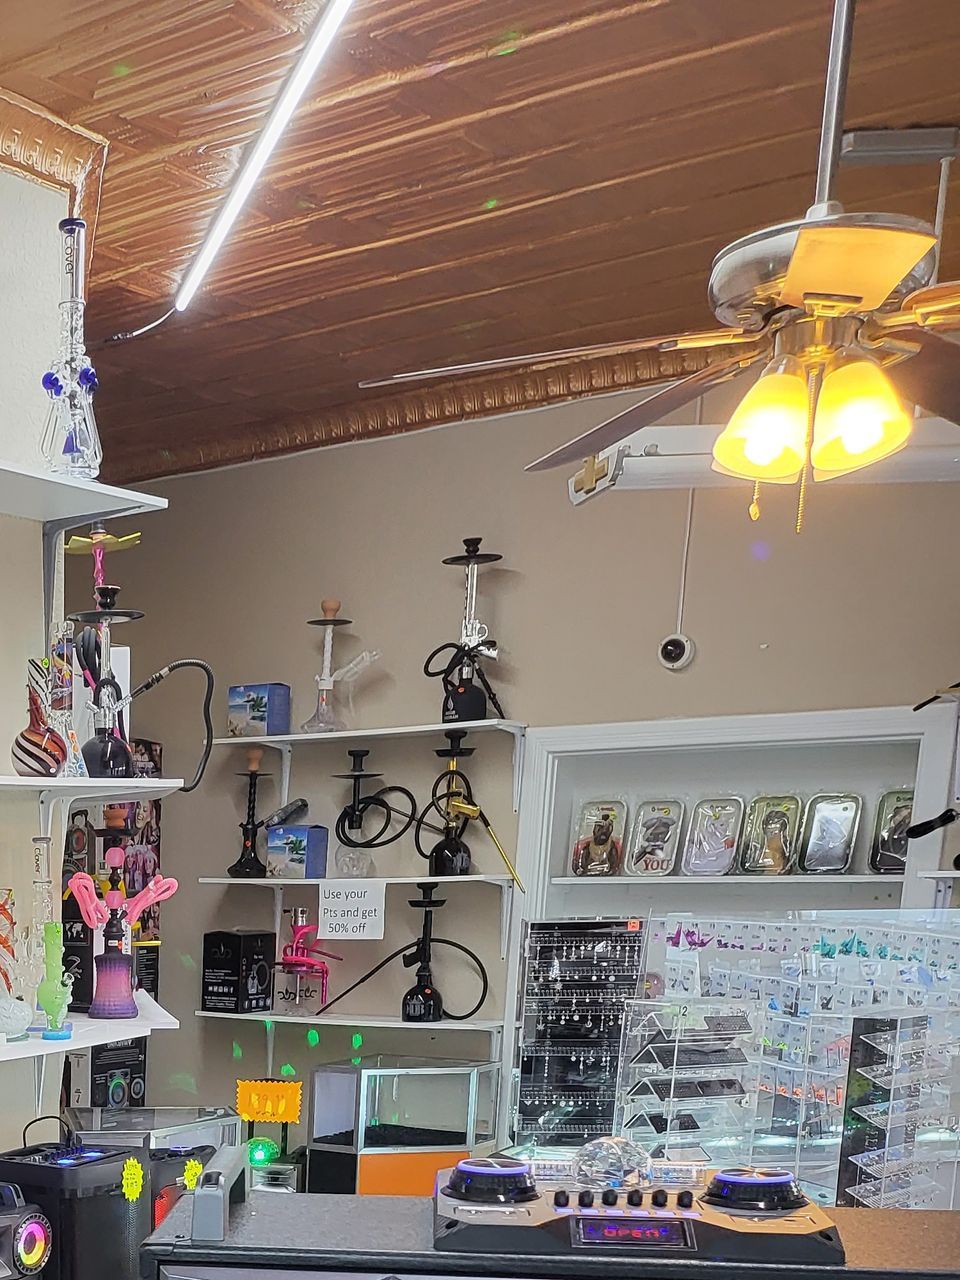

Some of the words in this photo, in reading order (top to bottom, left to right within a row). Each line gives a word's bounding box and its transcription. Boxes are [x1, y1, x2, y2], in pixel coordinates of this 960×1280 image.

[323, 889, 342, 899] Use
[344, 890, 368, 901] your
[323, 907, 338, 918] Pts
[340, 907, 359, 918] and
[361, 907, 378, 920] get
[328, 922, 349, 933] 50%
[351, 922, 367, 933] off
